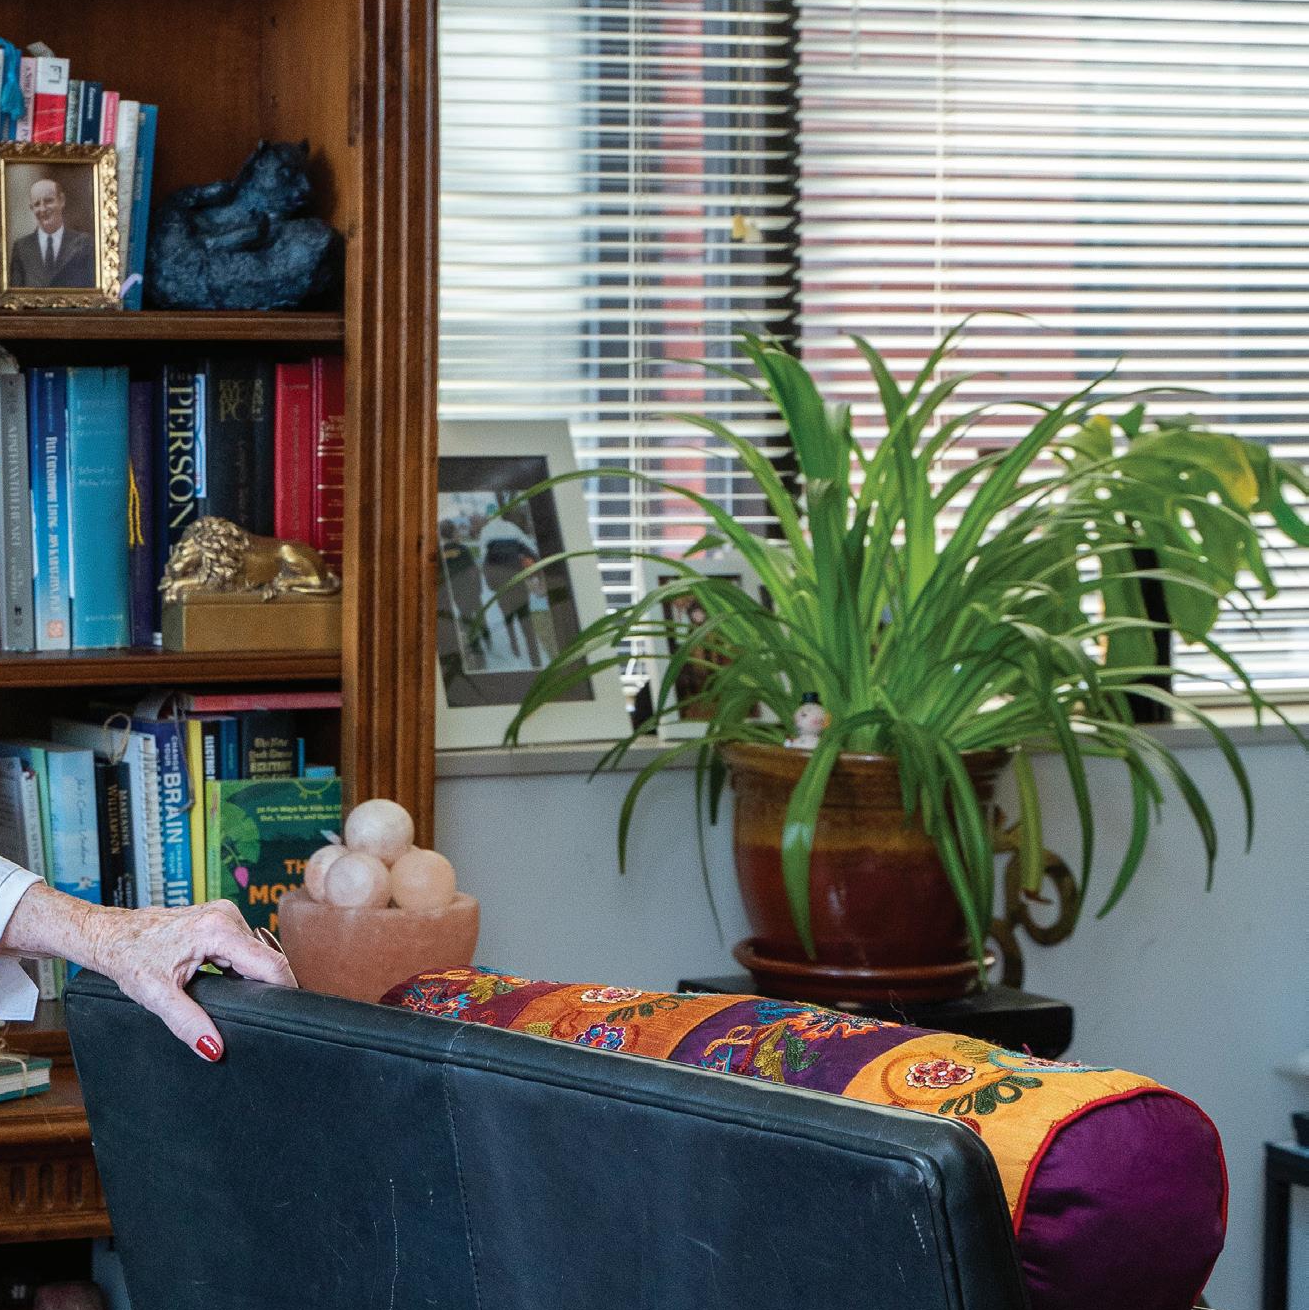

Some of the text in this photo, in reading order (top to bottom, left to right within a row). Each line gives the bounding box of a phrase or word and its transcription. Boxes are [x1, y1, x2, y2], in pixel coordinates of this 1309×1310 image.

[169, 386, 194, 529] PERSON
[163, 743, 171, 766] YOUR
[170, 735, 179, 770] CHANGE
[163, 772, 184, 844] BRAIN
[175, 844, 184, 879] CHANGE
[283, 859, 306, 874] TH
[167, 880, 189, 907] lif
